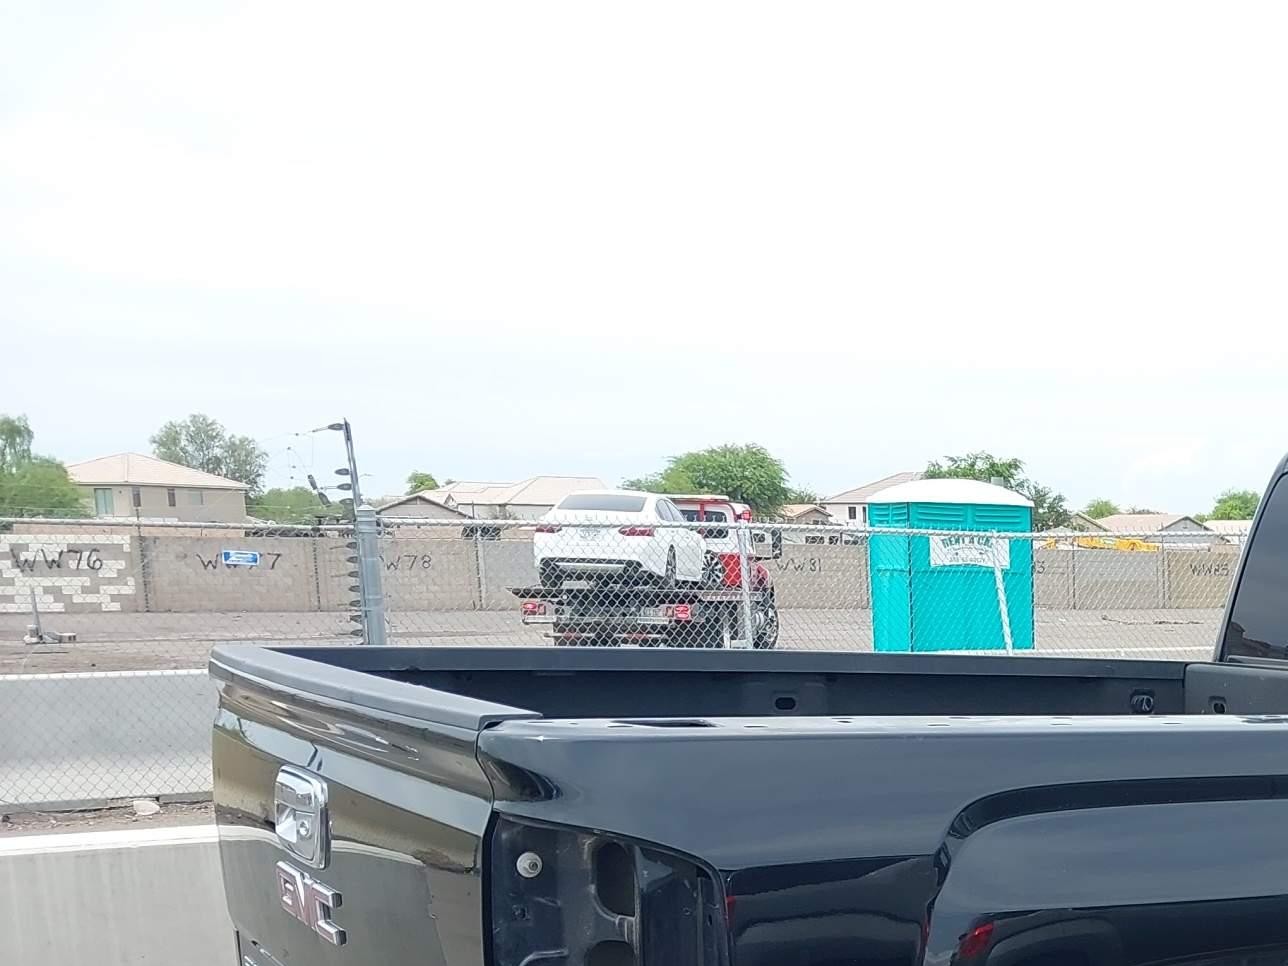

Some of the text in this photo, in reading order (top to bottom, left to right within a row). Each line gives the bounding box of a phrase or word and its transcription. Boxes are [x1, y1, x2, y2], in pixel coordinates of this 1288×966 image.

[10, 548, 103, 572] WW76
[775, 558, 822, 572] WW81
[276, 861, 348, 946] GMC
